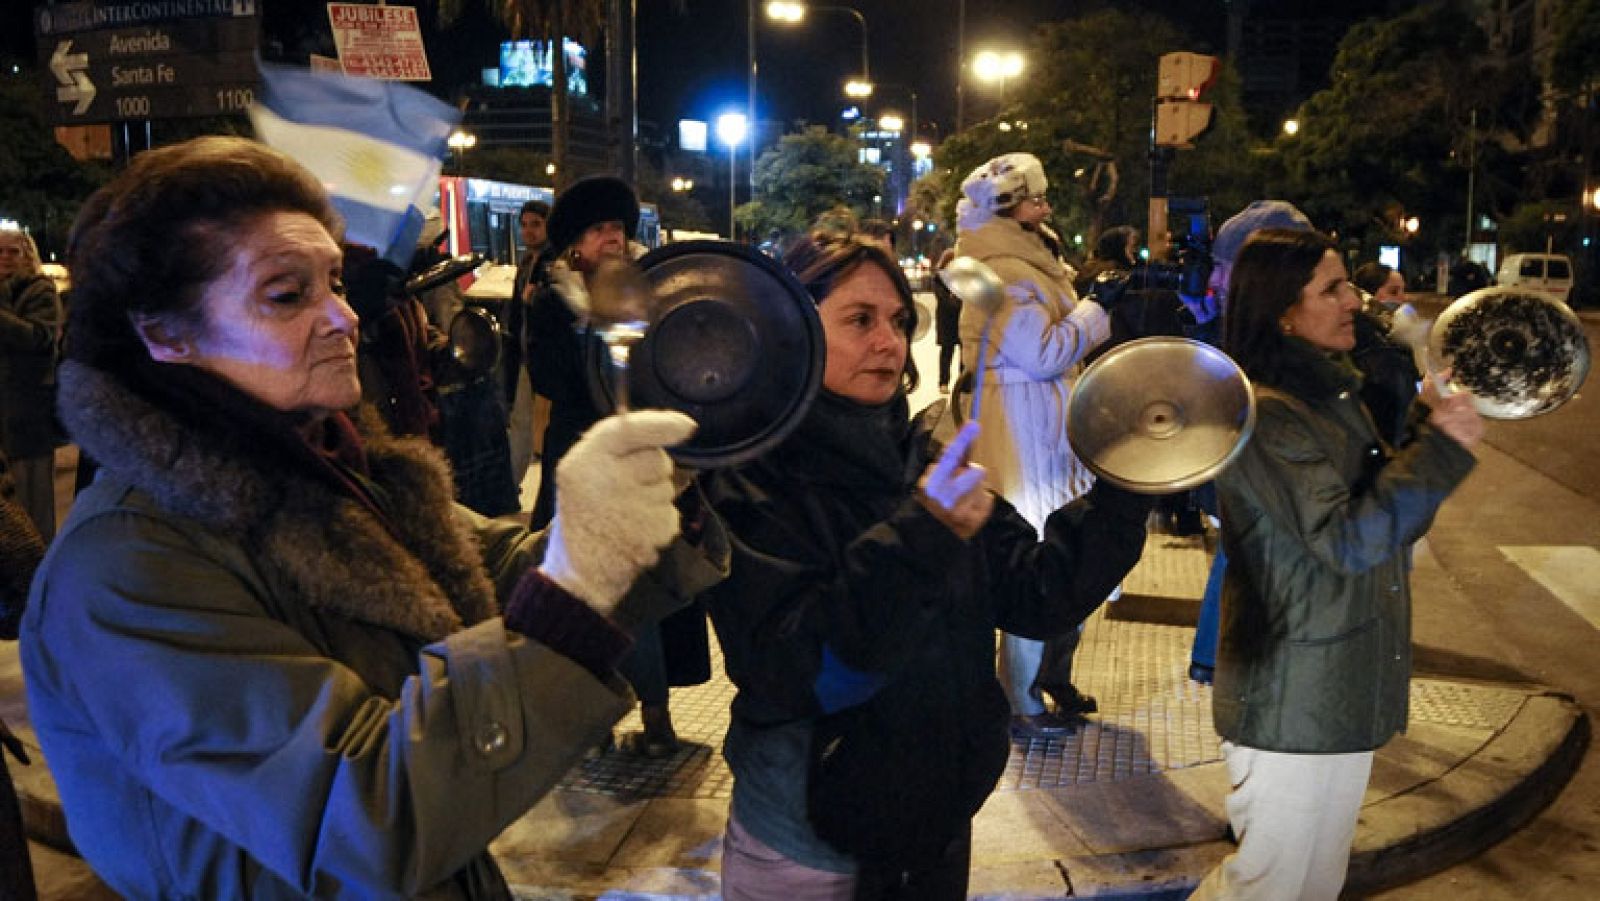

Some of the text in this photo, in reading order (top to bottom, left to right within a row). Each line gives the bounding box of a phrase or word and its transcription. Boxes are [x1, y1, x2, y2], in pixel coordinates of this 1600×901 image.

[109, 31, 170, 53] Avenida
[112, 63, 176, 86] Santa Fe
[116, 90, 252, 117] 1000 1100
